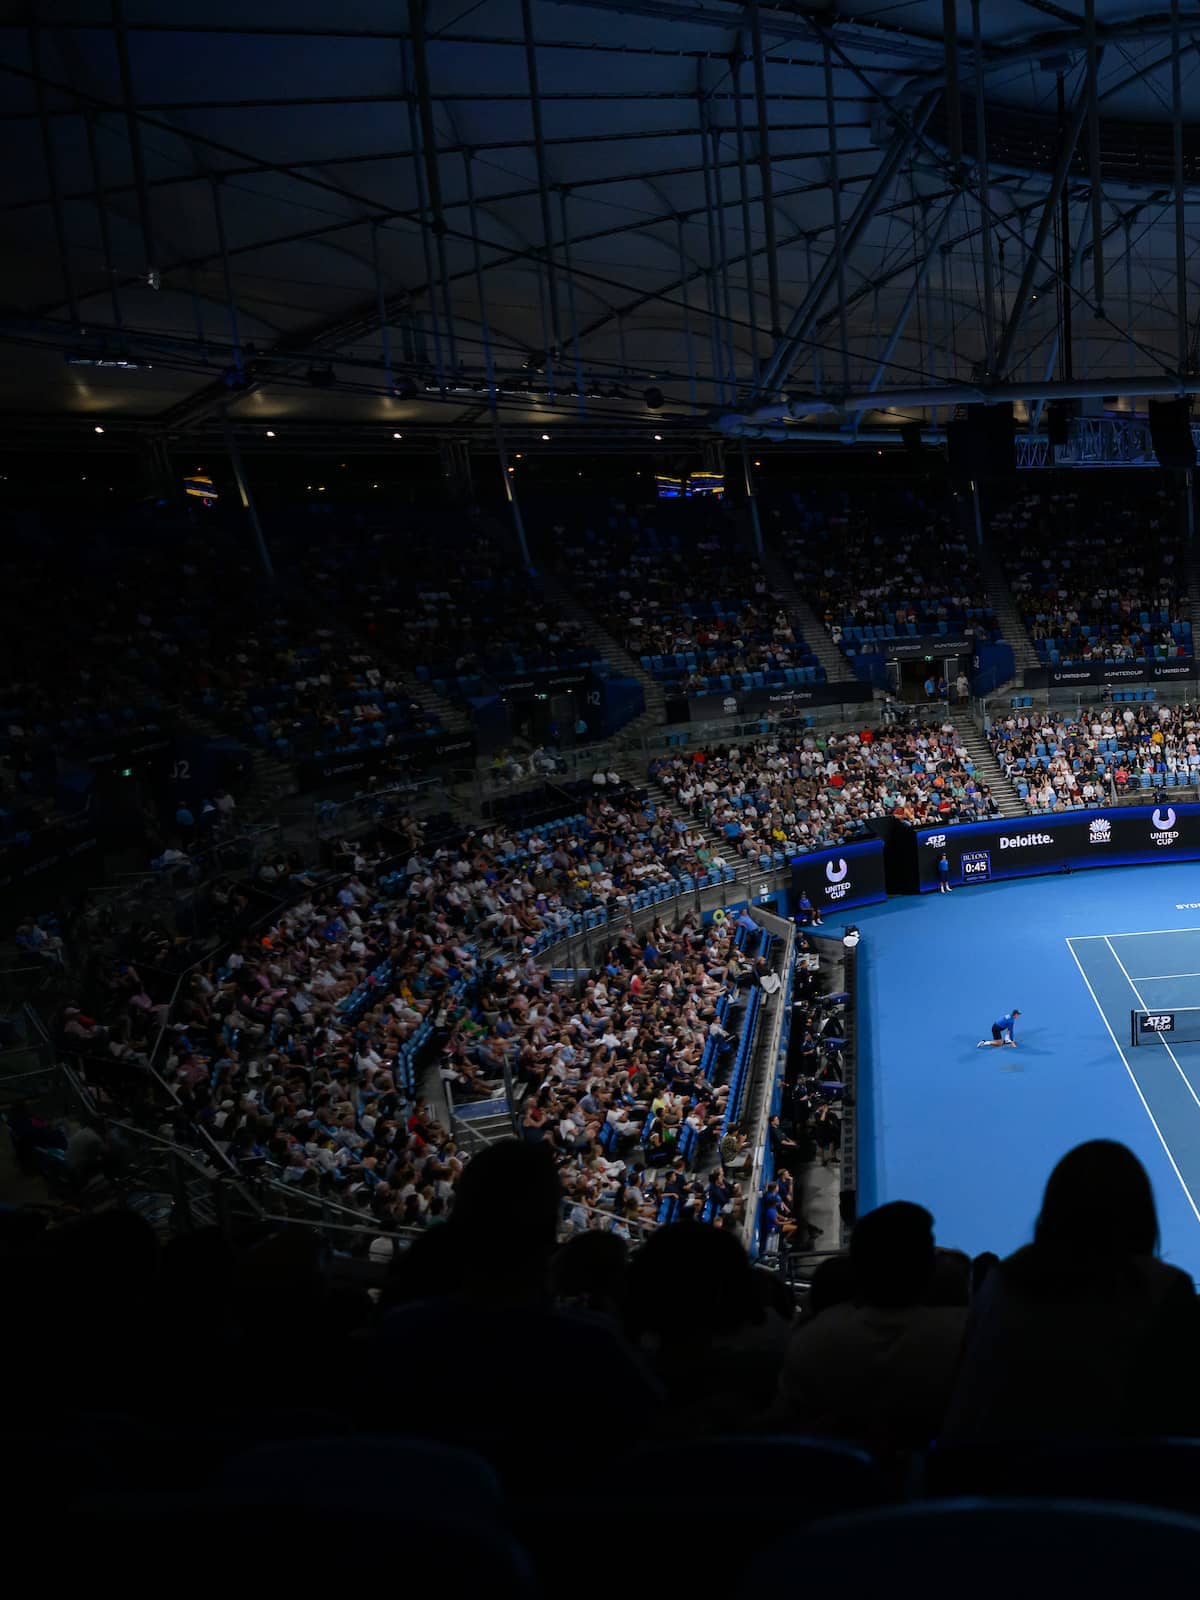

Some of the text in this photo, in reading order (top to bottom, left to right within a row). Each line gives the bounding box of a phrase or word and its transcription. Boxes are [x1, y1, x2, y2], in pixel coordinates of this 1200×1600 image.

[1089, 831, 1112, 841] NSW
[1150, 831, 1179, 840] UNITED
[999, 833, 1054, 849] Deloitte.
[1156, 838, 1173, 846] CUP
[965, 862, 987, 873] 0:45
[825, 882, 851, 894] UNITED
[830, 890, 846, 899] CUP
